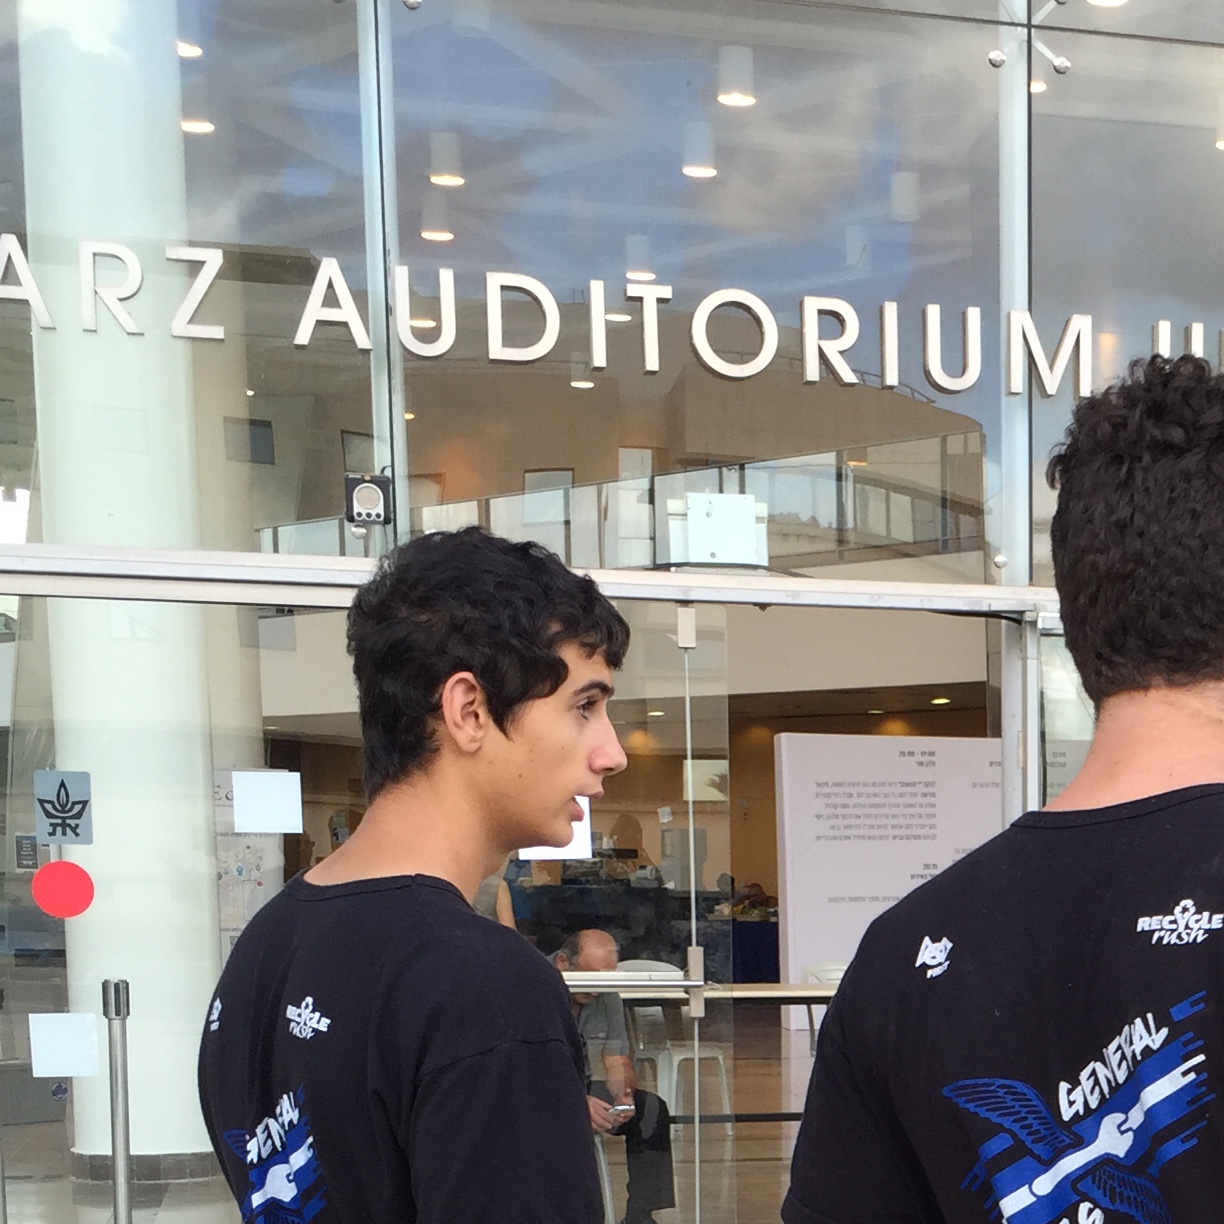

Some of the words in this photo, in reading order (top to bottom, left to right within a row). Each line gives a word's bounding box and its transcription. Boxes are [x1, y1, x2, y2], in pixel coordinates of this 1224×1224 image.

[293, 256, 1093, 397] AUDITORIUM
[1136, 908, 1224, 933] RECYCLE
[1151, 929, 1208, 945] rush
[1059, 1012, 1169, 1121] GENERAL
